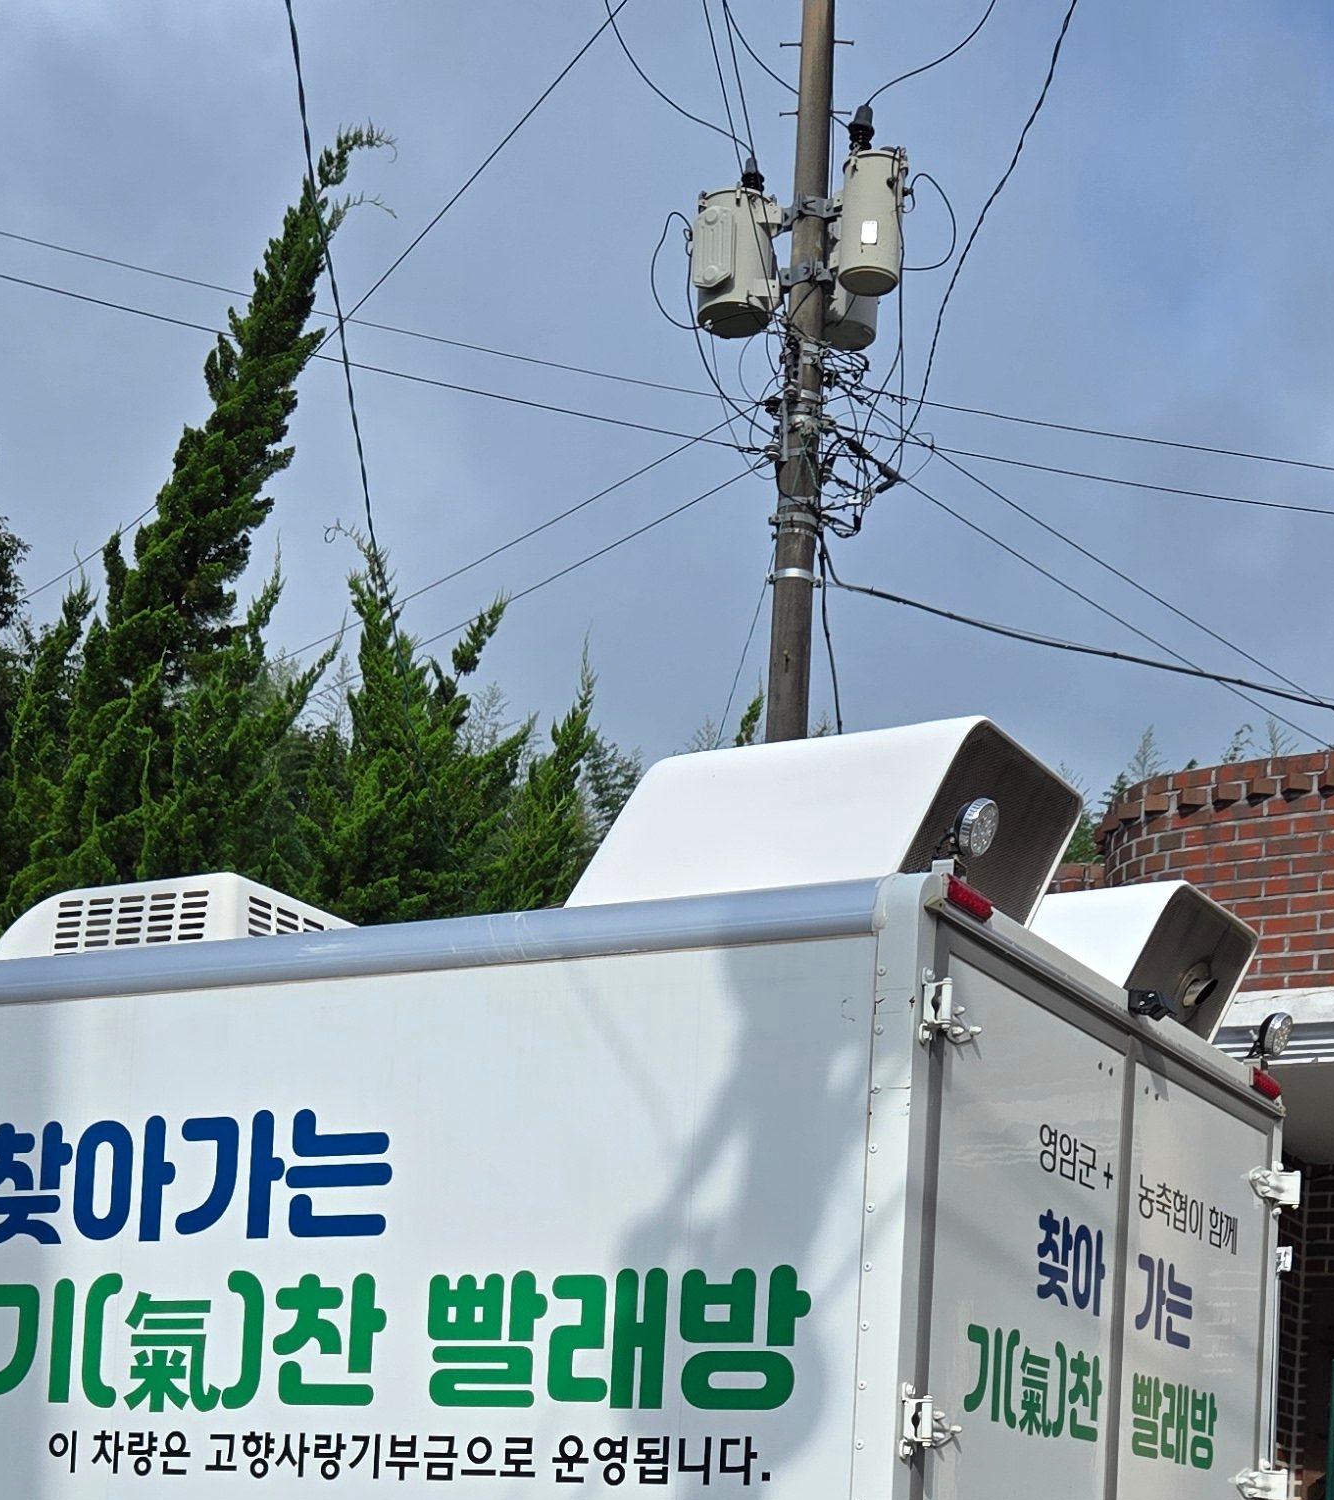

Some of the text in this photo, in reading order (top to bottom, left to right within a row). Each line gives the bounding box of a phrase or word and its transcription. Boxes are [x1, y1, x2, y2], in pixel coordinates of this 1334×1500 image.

[1040, 1123, 1096, 1189] 영암군
[1138, 1174, 1204, 1241] 농축협이
[1209, 1206, 1238, 1255] 함께
[428, 1264, 811, 1411] 빨래방
[964, 1323, 1217, 1470] 기(氣)찬 빨래방
[48, 1429, 772, 1487] 이 차량은 고향사랑기부금으로 운영됩니다.
